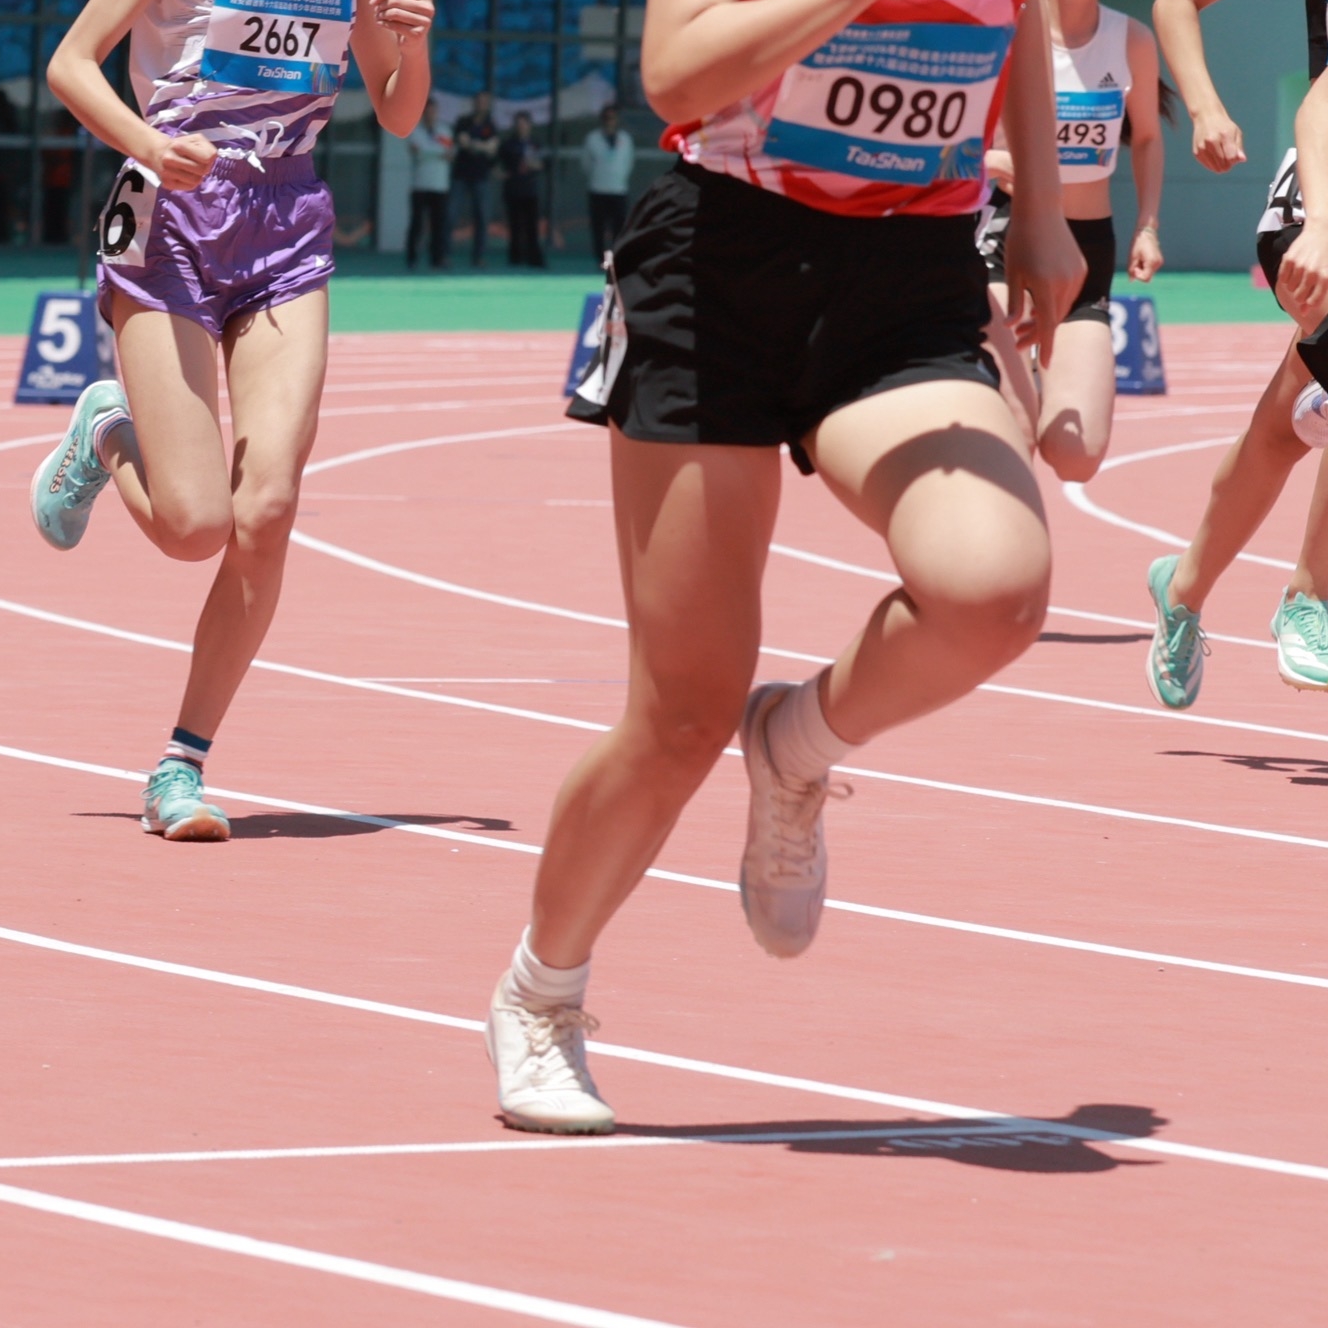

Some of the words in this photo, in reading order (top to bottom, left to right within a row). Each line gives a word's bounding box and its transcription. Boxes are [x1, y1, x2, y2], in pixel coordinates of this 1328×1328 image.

[239, 16, 321, 58] 2667
[257, 65, 302, 80] TaiShan
[825, 75, 967, 140] 0980
[845, 144, 926, 173] TaiShan
[103, 169, 145, 257] 6
[36, 299, 82, 363] 5
